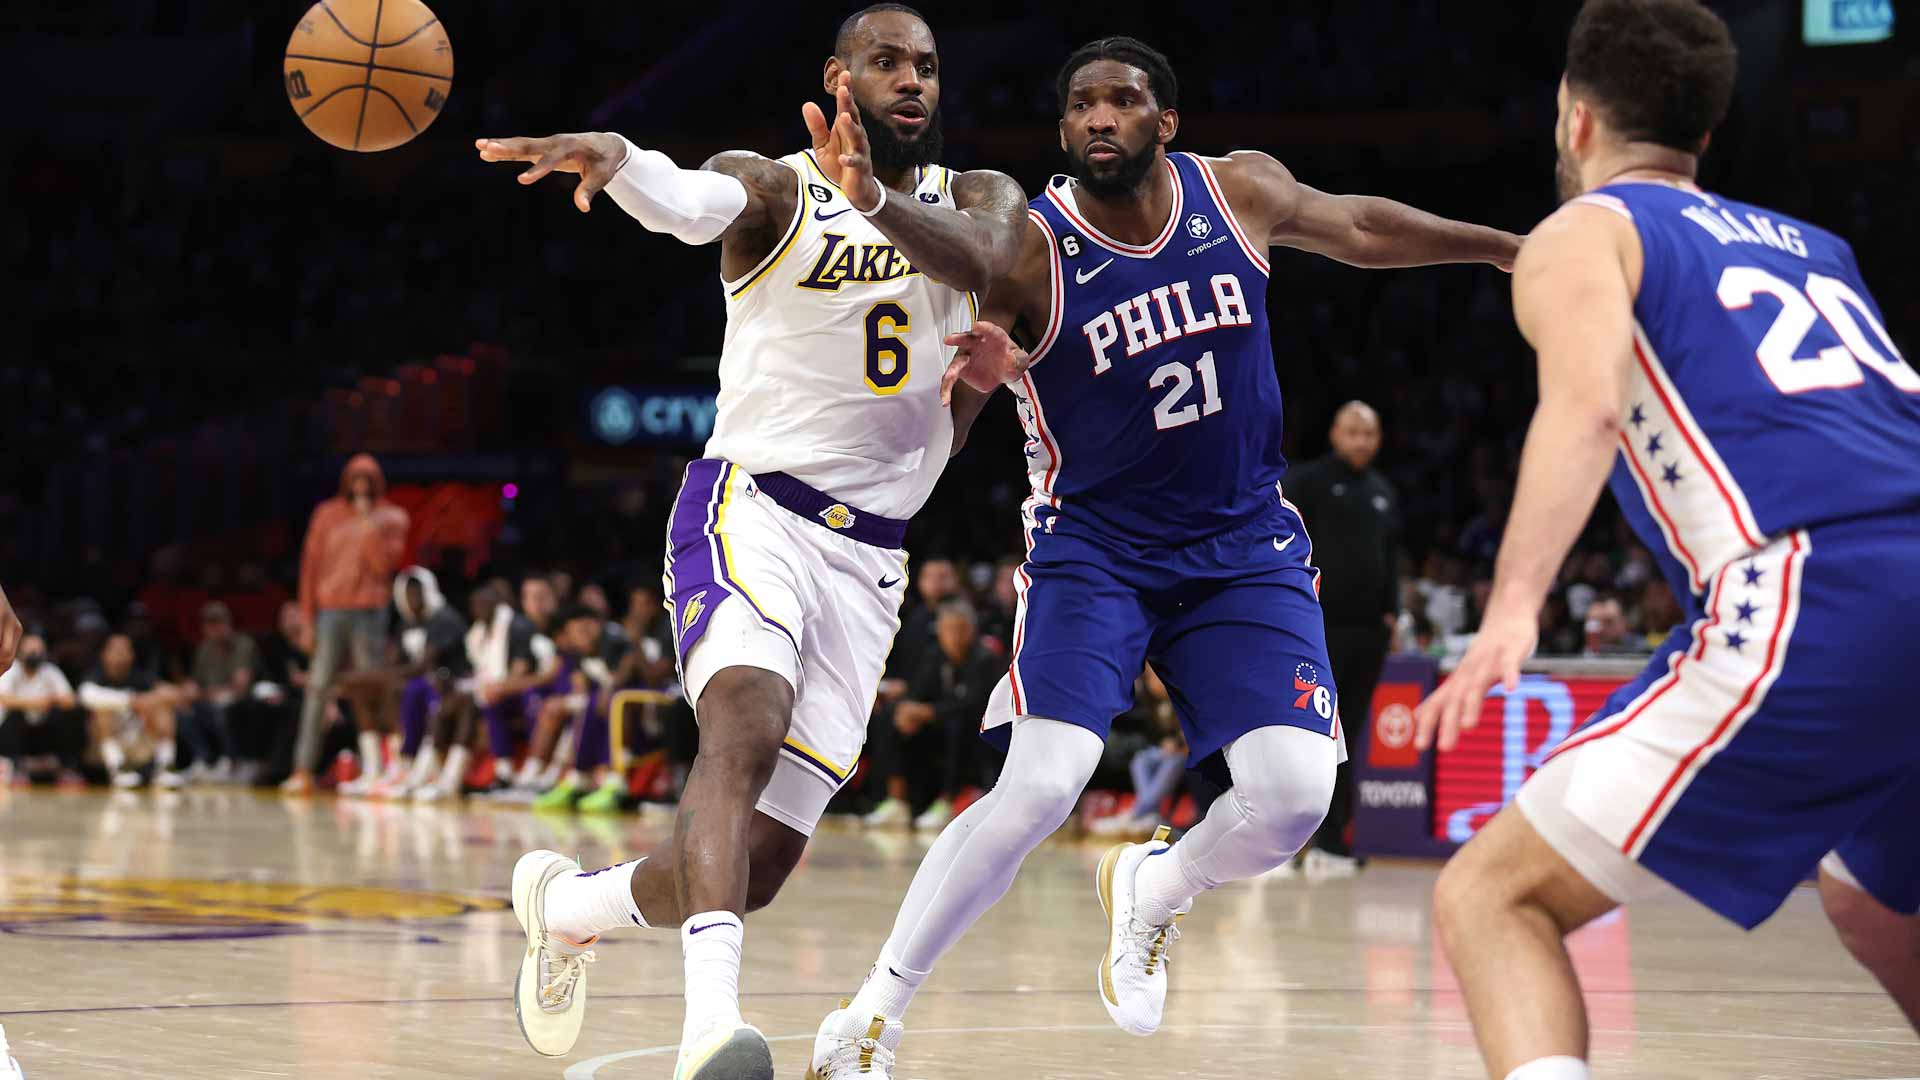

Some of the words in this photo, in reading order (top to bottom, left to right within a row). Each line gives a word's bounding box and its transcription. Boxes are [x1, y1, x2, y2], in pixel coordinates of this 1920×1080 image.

[1063, 236, 1081, 257] 6
[1187, 235, 1228, 257] crypto.com
[1680, 205, 1808, 259] NIANG
[796, 232, 922, 293] LAKE
[863, 301, 911, 395] 6
[1082, 273, 1252, 377] PHILA
[1716, 266, 1920, 394] 20
[1148, 350, 1223, 431] 21
[1293, 675, 1331, 719] 76
[1359, 780, 1427, 808] TOYOTA
